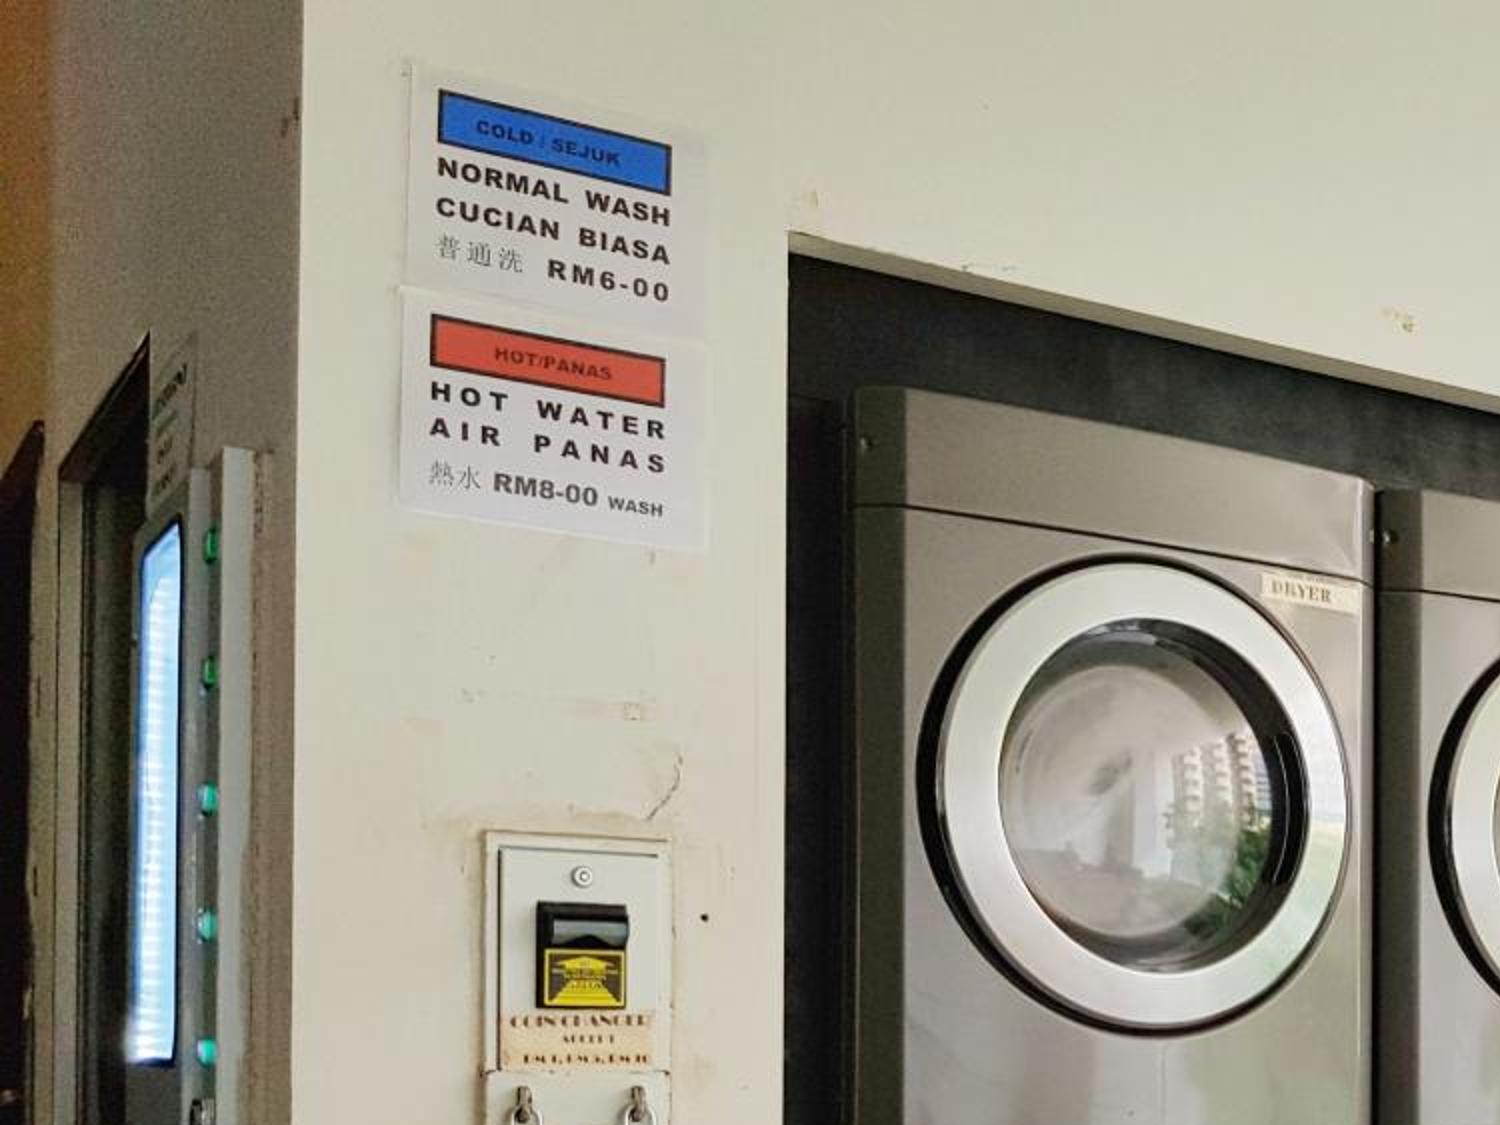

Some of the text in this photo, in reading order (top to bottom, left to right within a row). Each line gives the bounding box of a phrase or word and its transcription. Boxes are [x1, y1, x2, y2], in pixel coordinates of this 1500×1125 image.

[475, 120, 534, 146] COLD
[551, 137, 622, 167] SEJUK
[436, 156, 671, 227] NORMAL WASH
[435, 197, 671, 265] CUCIAN BIASA
[435, 232, 670, 303] 普通洗 RM6-00
[494, 347, 613, 381] HOT/PANAS
[430, 380, 666, 440] HOT WATER
[428, 417, 666, 473] AIR PANAS
[493, 472, 599, 507] RM8-00
[607, 495, 664, 517] WASH
[1271, 580, 1331, 603] DRYER
